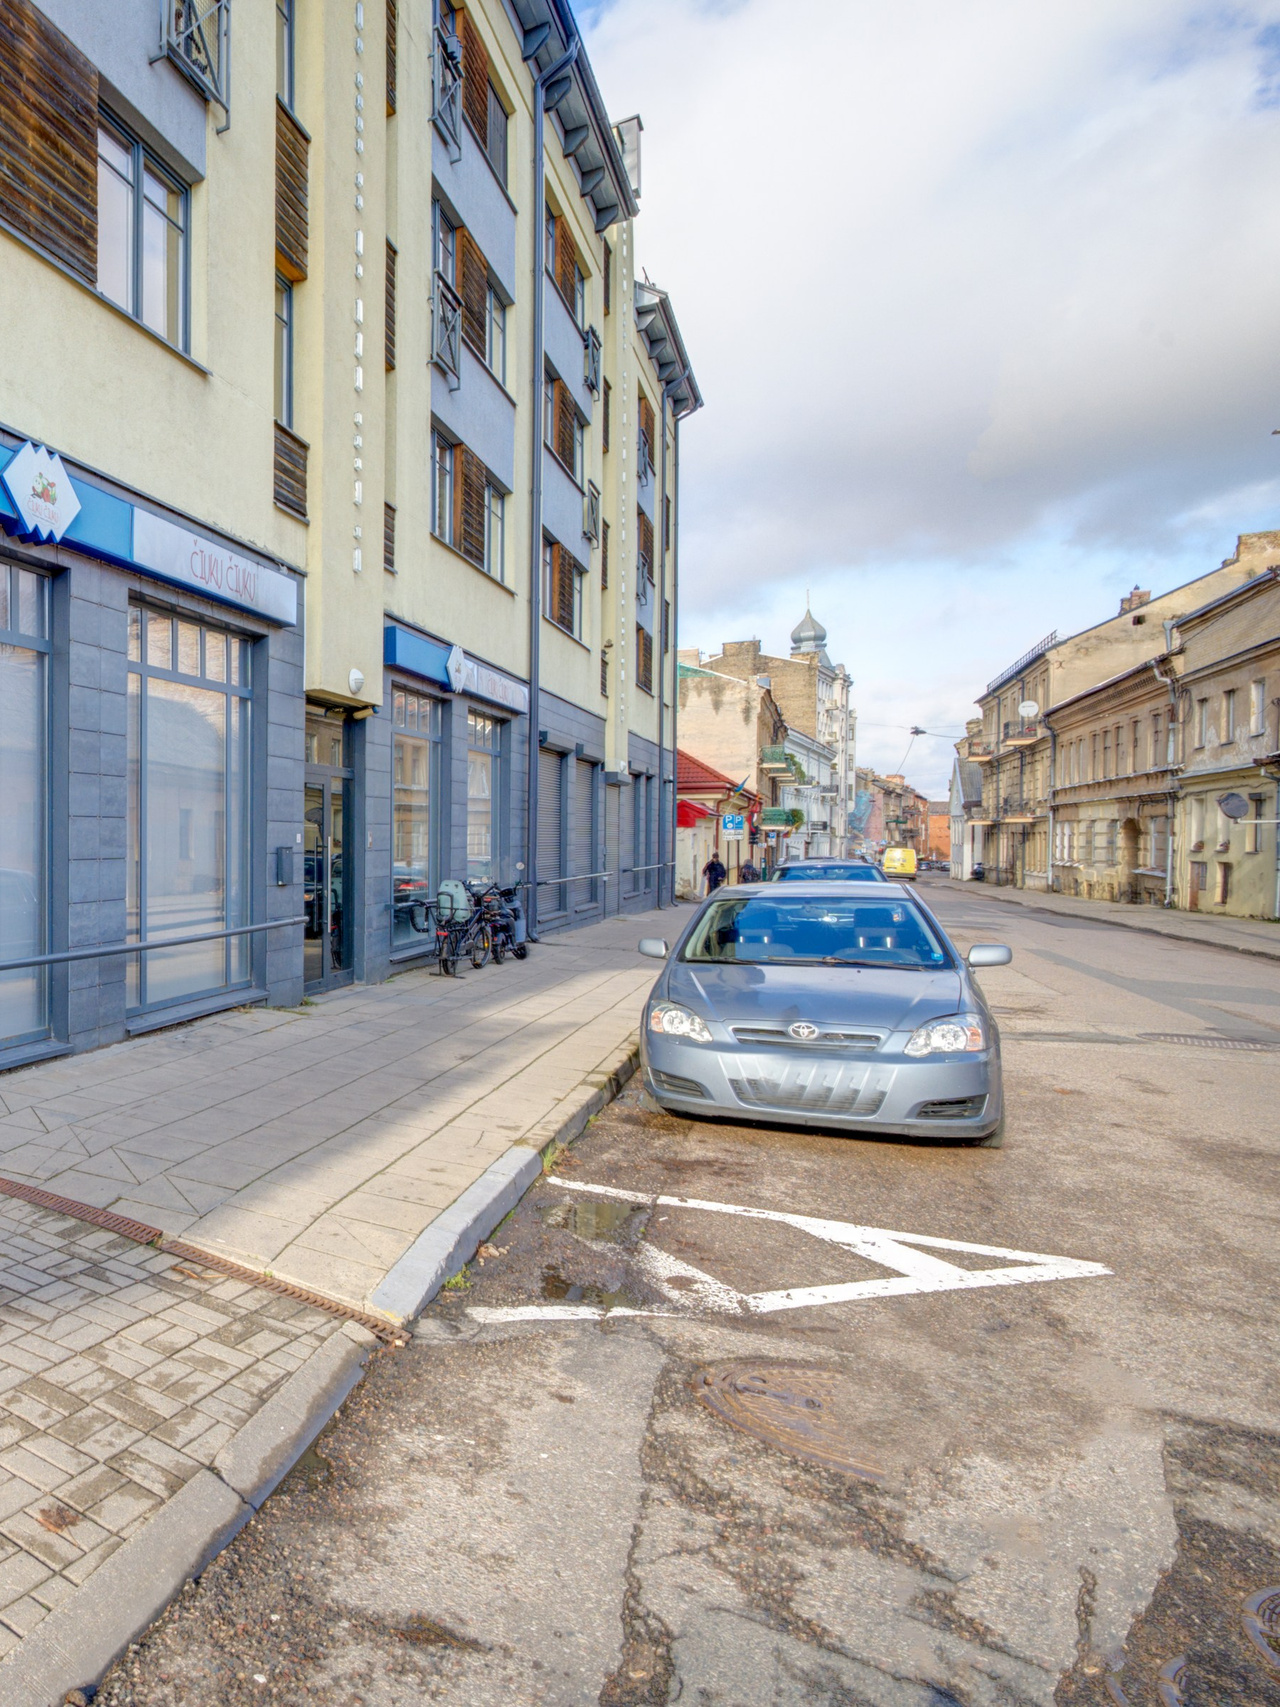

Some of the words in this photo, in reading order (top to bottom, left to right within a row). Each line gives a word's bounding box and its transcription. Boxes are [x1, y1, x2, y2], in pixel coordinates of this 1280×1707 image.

[190, 539, 223, 589] ČIUKU
[226, 555, 255, 602] ČIUKU
[725, 815, 733, 824] P
[735, 816, 742, 824] P
